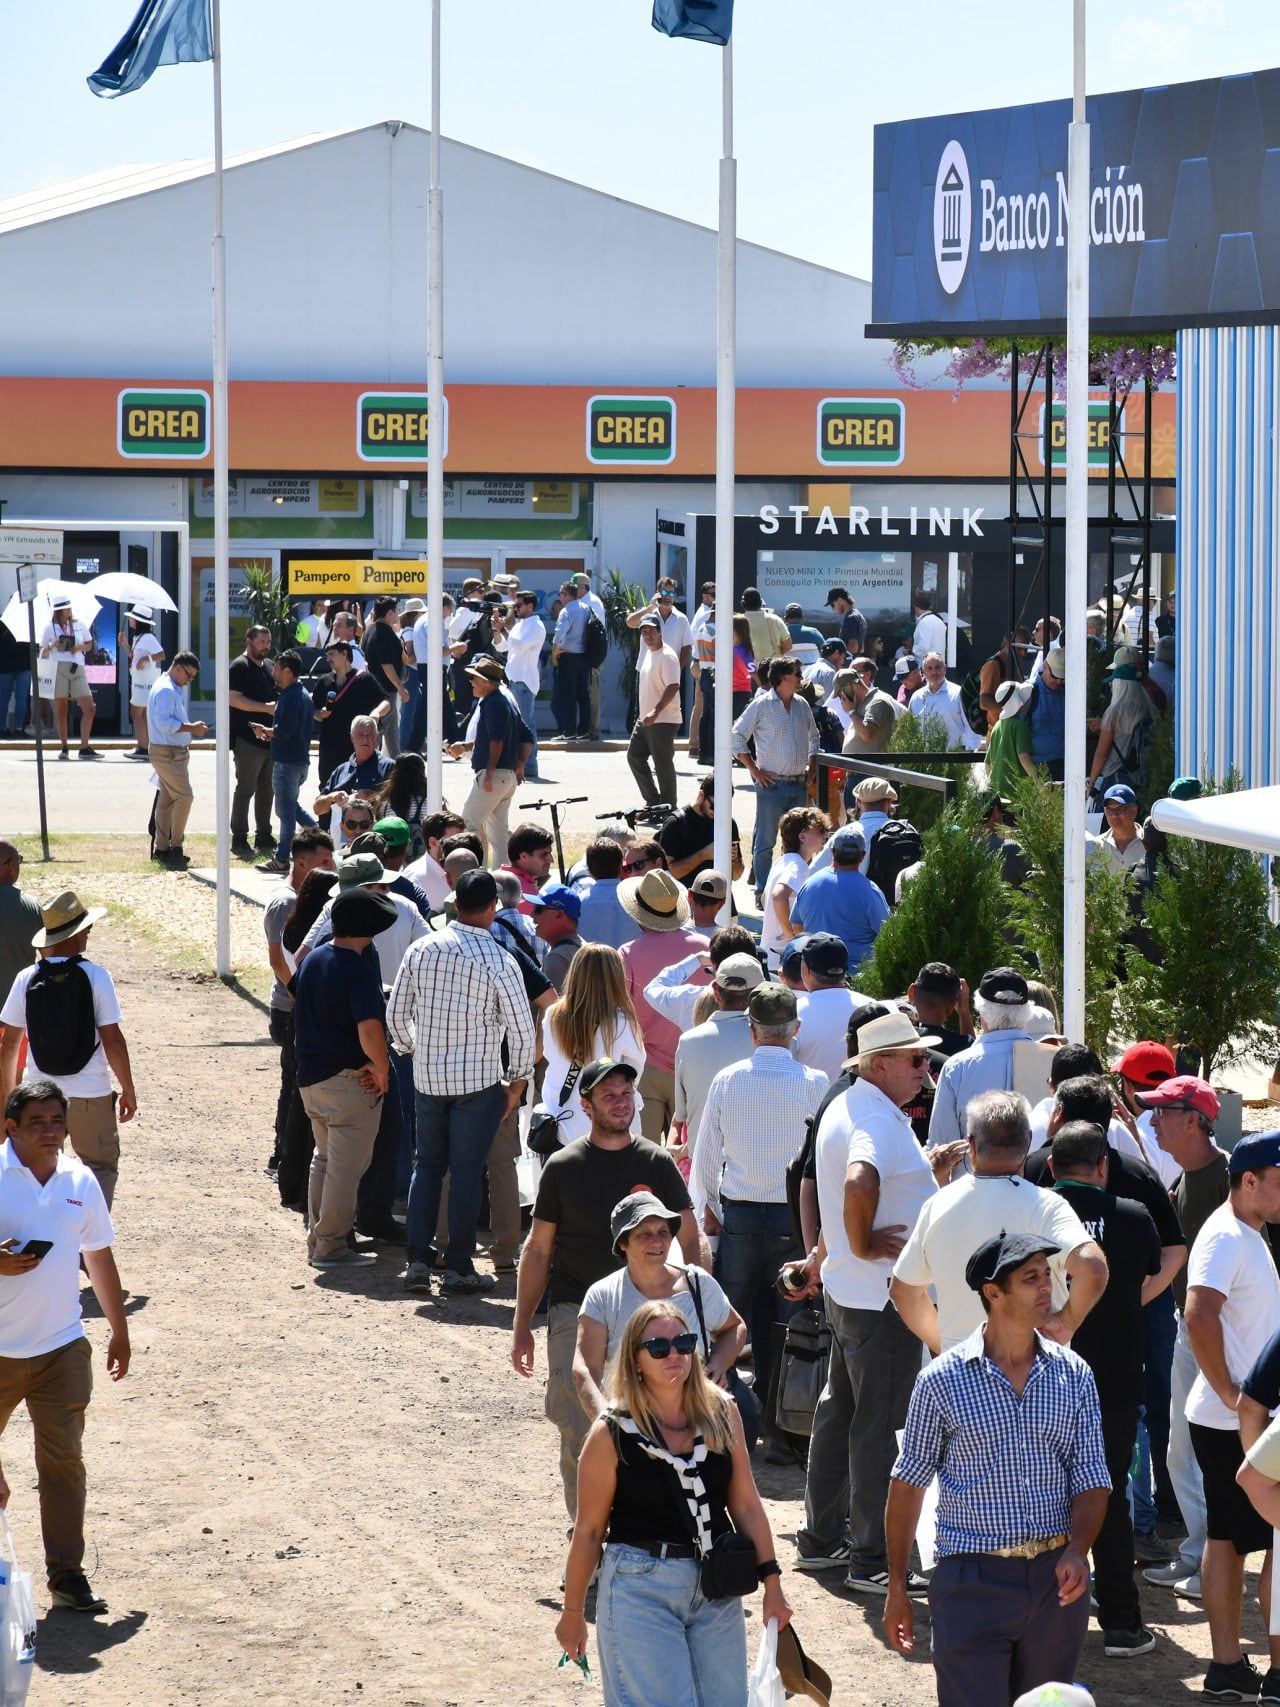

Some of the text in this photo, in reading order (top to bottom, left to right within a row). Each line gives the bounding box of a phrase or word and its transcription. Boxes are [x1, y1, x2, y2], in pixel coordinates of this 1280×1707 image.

[980, 165, 1145, 252] Banco Nción
[128, 409, 199, 438] CREA
[597, 416, 665, 444] CREA
[827, 418, 895, 446] CREA
[1051, 420, 1110, 447] CEA
[466, 489, 525, 497] AGRONEGOCIOS
[759, 505, 985, 537] STARLINK
[294, 569, 351, 585] Pampero
[363, 566, 425, 587] Pampero
[765, 567, 903, 577] NUEVO MINI X Primicia Mundial
[814, 578, 847, 588] Primero
[862, 579, 903, 588] Argentina
